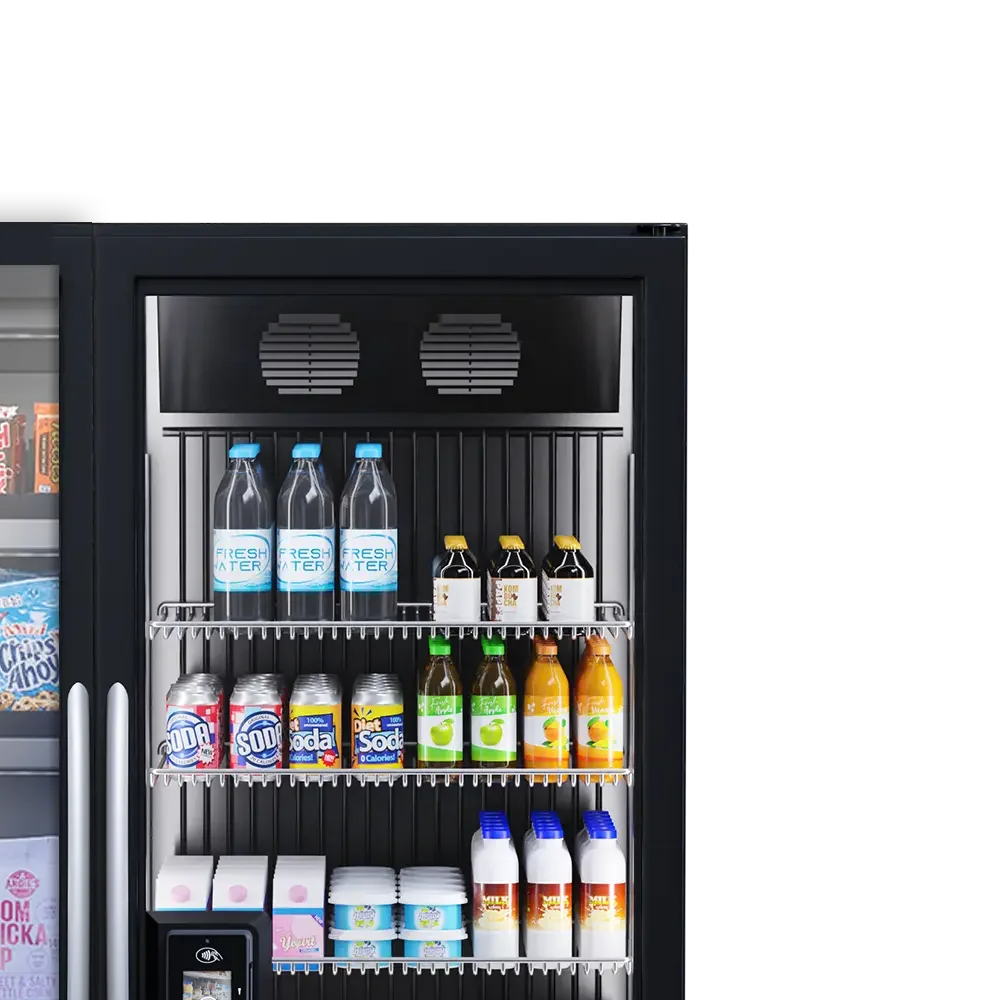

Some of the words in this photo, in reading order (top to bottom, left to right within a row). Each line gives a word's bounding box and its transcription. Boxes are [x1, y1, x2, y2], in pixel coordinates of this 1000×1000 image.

[216, 548, 267, 559] FRESH
[279, 548, 331, 559] FRESH
[342, 548, 394, 559] FRESH
[306, 716, 325, 724] 100%
[354, 718, 382, 732] Diet
[279, 935, 318, 952] Yogurt
